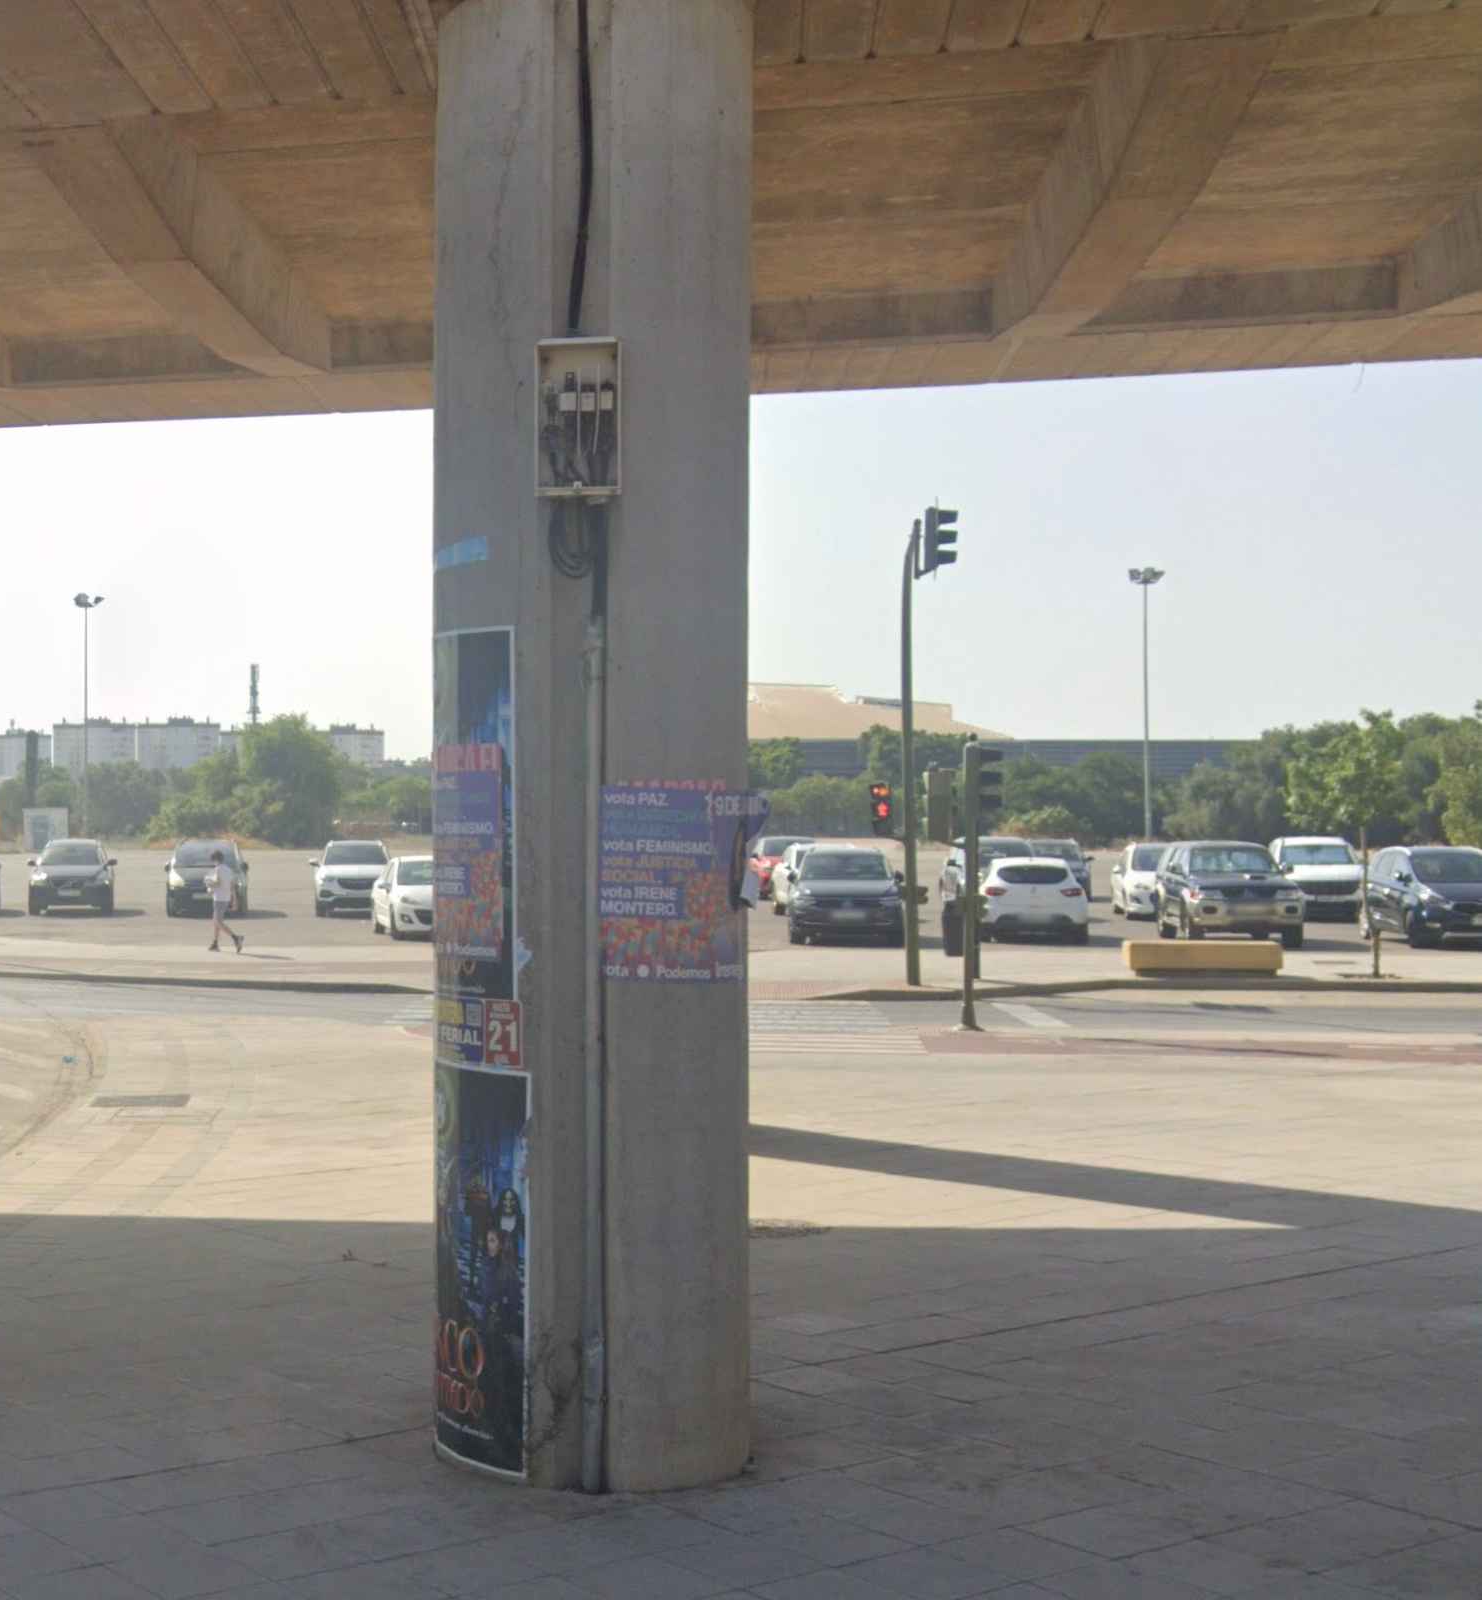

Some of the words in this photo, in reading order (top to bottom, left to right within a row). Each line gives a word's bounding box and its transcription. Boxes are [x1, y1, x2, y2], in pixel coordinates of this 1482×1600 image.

[603, 792, 636, 805] vota
[602, 839, 633, 852] vota
[600, 885, 632, 898] vota
[633, 885, 679, 901] IRENE
[656, 964, 711, 979] Podemos
[487, 1020, 518, 1053] 21
